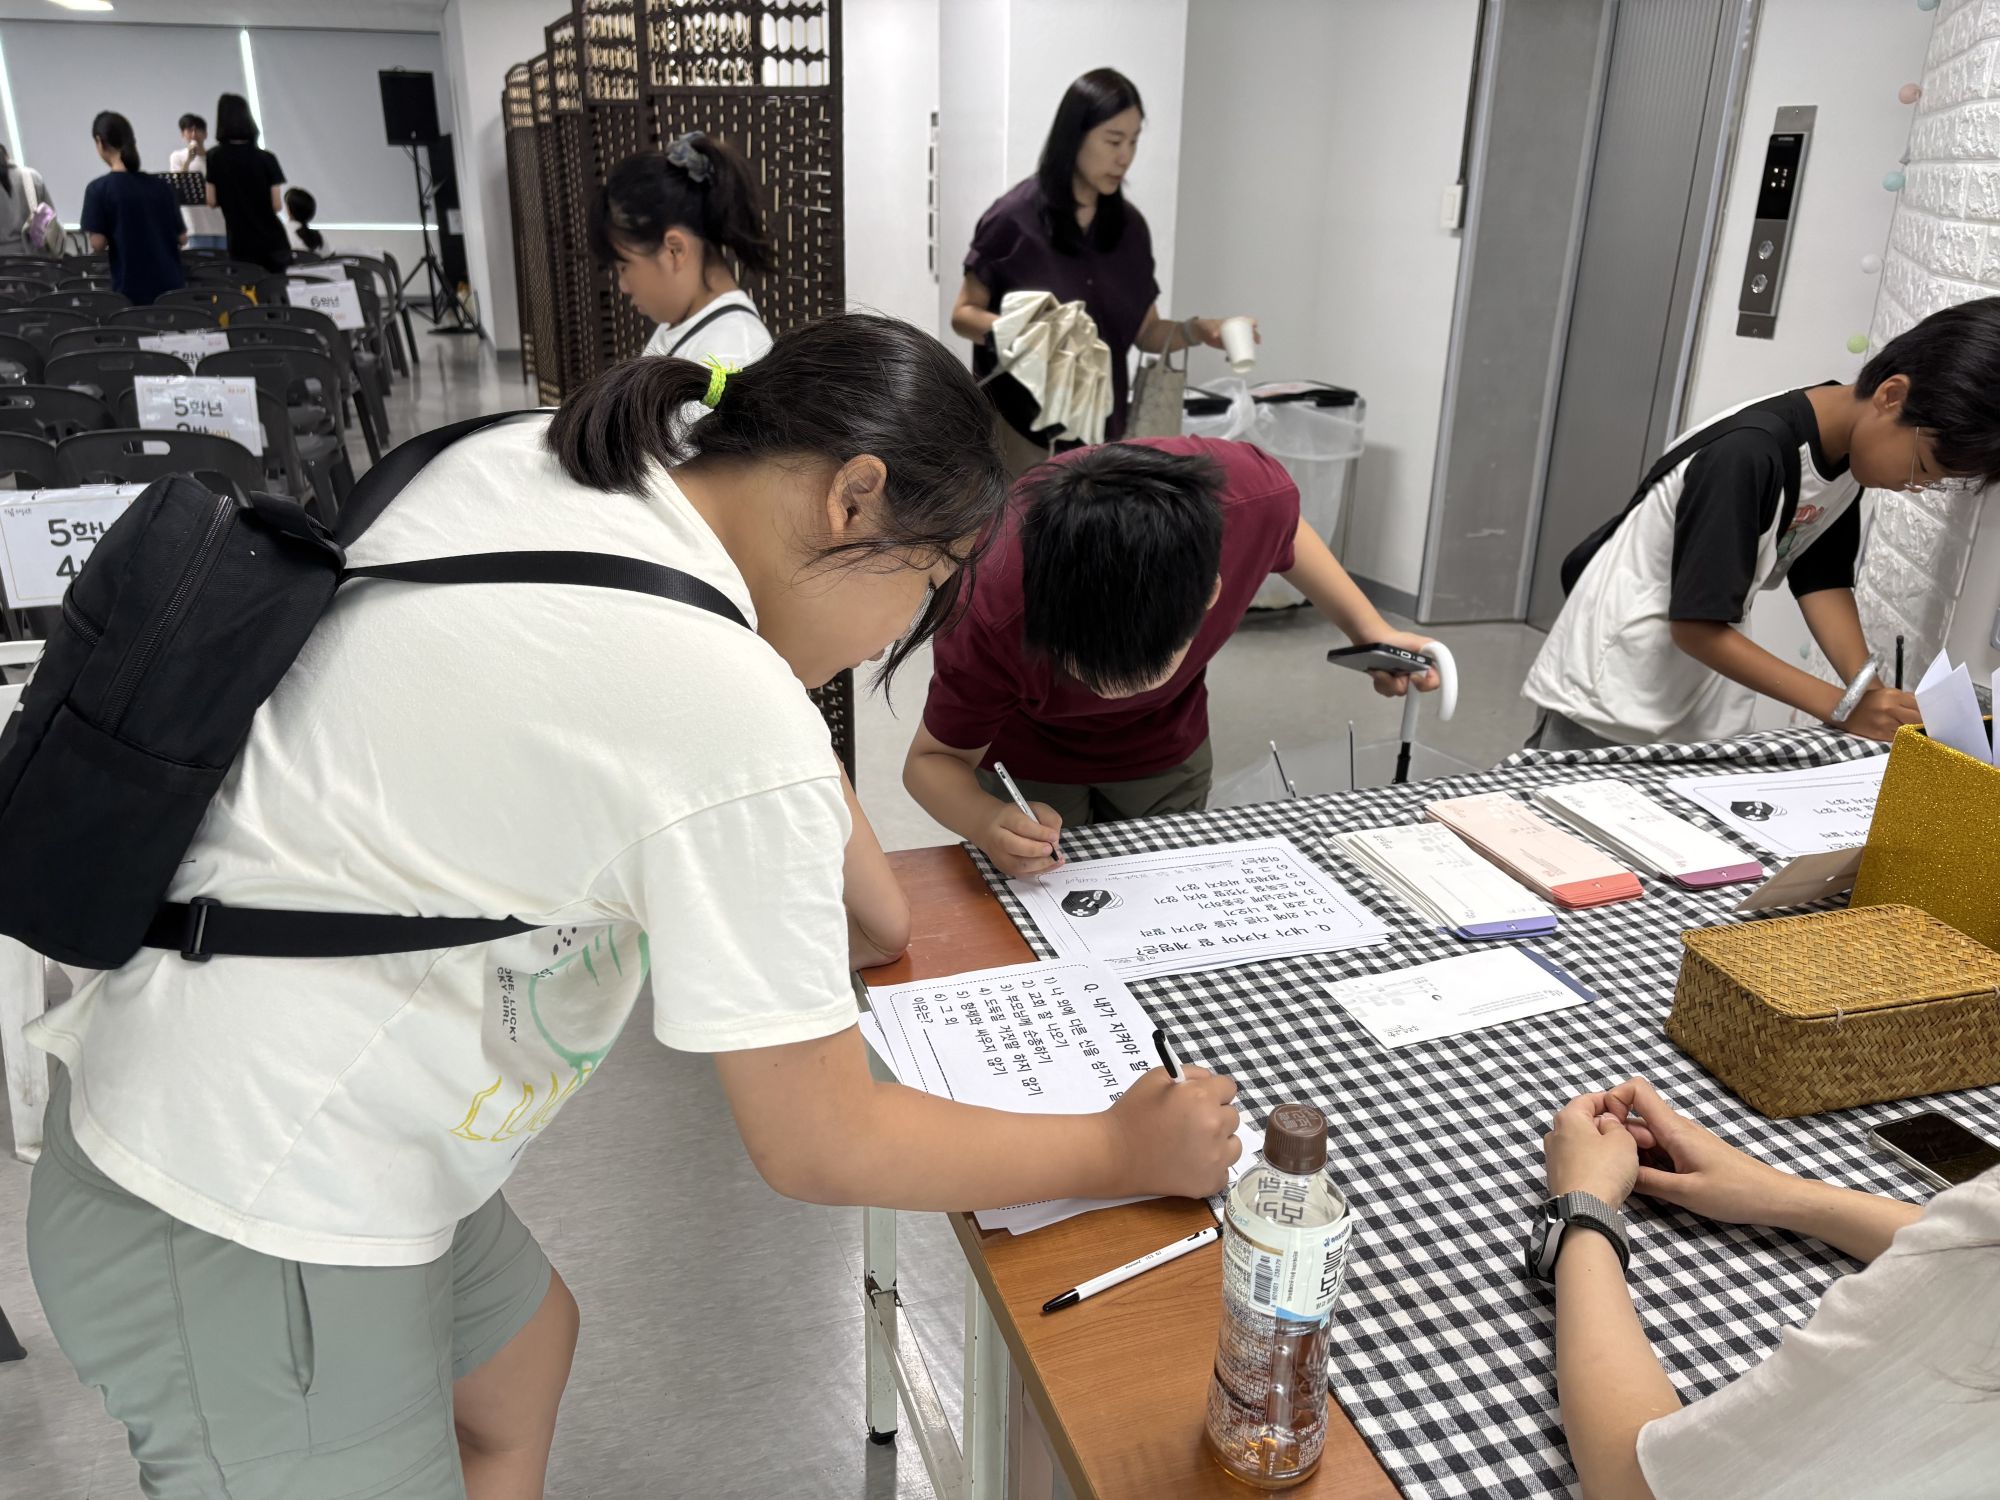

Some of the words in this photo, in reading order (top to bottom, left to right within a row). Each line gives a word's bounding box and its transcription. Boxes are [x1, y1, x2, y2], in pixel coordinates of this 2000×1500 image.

[174, 396, 224, 417] 5학년
[56, 554, 85, 580] 4
[1241, 856, 1280, 865] 이유는?
[1205, 878, 1240, 889] 싸우지
[1245, 874, 1281, 884] 형제와
[1176, 883, 1200, 892] 않기
[1213, 887, 1249, 898] 거짓말
[1253, 883, 1289, 892] 도둑질
[1303, 888, 1317, 896] 3)
[1154, 895, 1179, 905] 않기
[1184, 892, 1208, 901] 하지
[1250, 891, 1298, 903] 부모님께
[1198, 897, 1246, 909] 순종하기
[1264, 903, 1278, 912] 잘
[1283, 900, 1308, 909] 교회
[1223, 906, 1261, 917] 나오기
[1274, 912, 1299, 921] 외에
[1304, 909, 1318, 917] 나
[1322, 907, 1335, 915] 1)
[1214, 919, 1238, 928] 신을
[1244, 916, 1270, 925] 다른
[1140, 928, 1166, 938] 말라
[1171, 922, 1207, 934] 섬기지
[1276, 927, 1309, 938] 내가
[1315, 924, 1331, 932] Q.
[1198, 938, 1215, 948] 할
[1222, 932, 1270, 945] 지켜야
[1136, 942, 1191, 956] 계명은?
[1021, 979, 1037, 989] 2)
[1044, 976, 1058, 985] 1)
[978, 987, 993, 996] 4)
[1000, 983, 1015, 993] 3)
[1050, 987, 1065, 997] 나
[933, 993, 949, 1002] 6)
[956, 990, 971, 999] 5)
[1028, 991, 1047, 1009] 교회
[502, 996, 510, 1026] GIRL
[912, 996, 934, 1025] 이유는?
[939, 1005, 953, 1014] 그
[983, 998, 1007, 1022] 도둑질
[1007, 995, 1034, 1027] 부모님께
[1056, 999, 1076, 1017] 외에
[960, 1002, 984, 1026] 형제와
[1037, 1010, 1054, 1020] 잘
[1083, 983, 1099, 995] Q.
[1095, 997, 1116, 1018] 내가
[1111, 1022, 1141, 1055] 지켜야
[509, 1000, 517, 1043] LUCKY
[944, 1017, 959, 1026] 외
[1068, 1018, 1088, 1036] 다른
[976, 1027, 998, 1054] 싸우지
[999, 1024, 1022, 1050] 거짓말
[1047, 1023, 1070, 1049] 나오기
[1022, 1030, 1054, 1064] 순종하기
[1079, 1038, 1100, 1058] 신을
[986, 1056, 1009, 1076] 않기
[1012, 1053, 1033, 1073] 하지
[1091, 1060, 1119, 1088] 섬기지
[1021, 1076, 1044, 1097] 않기
